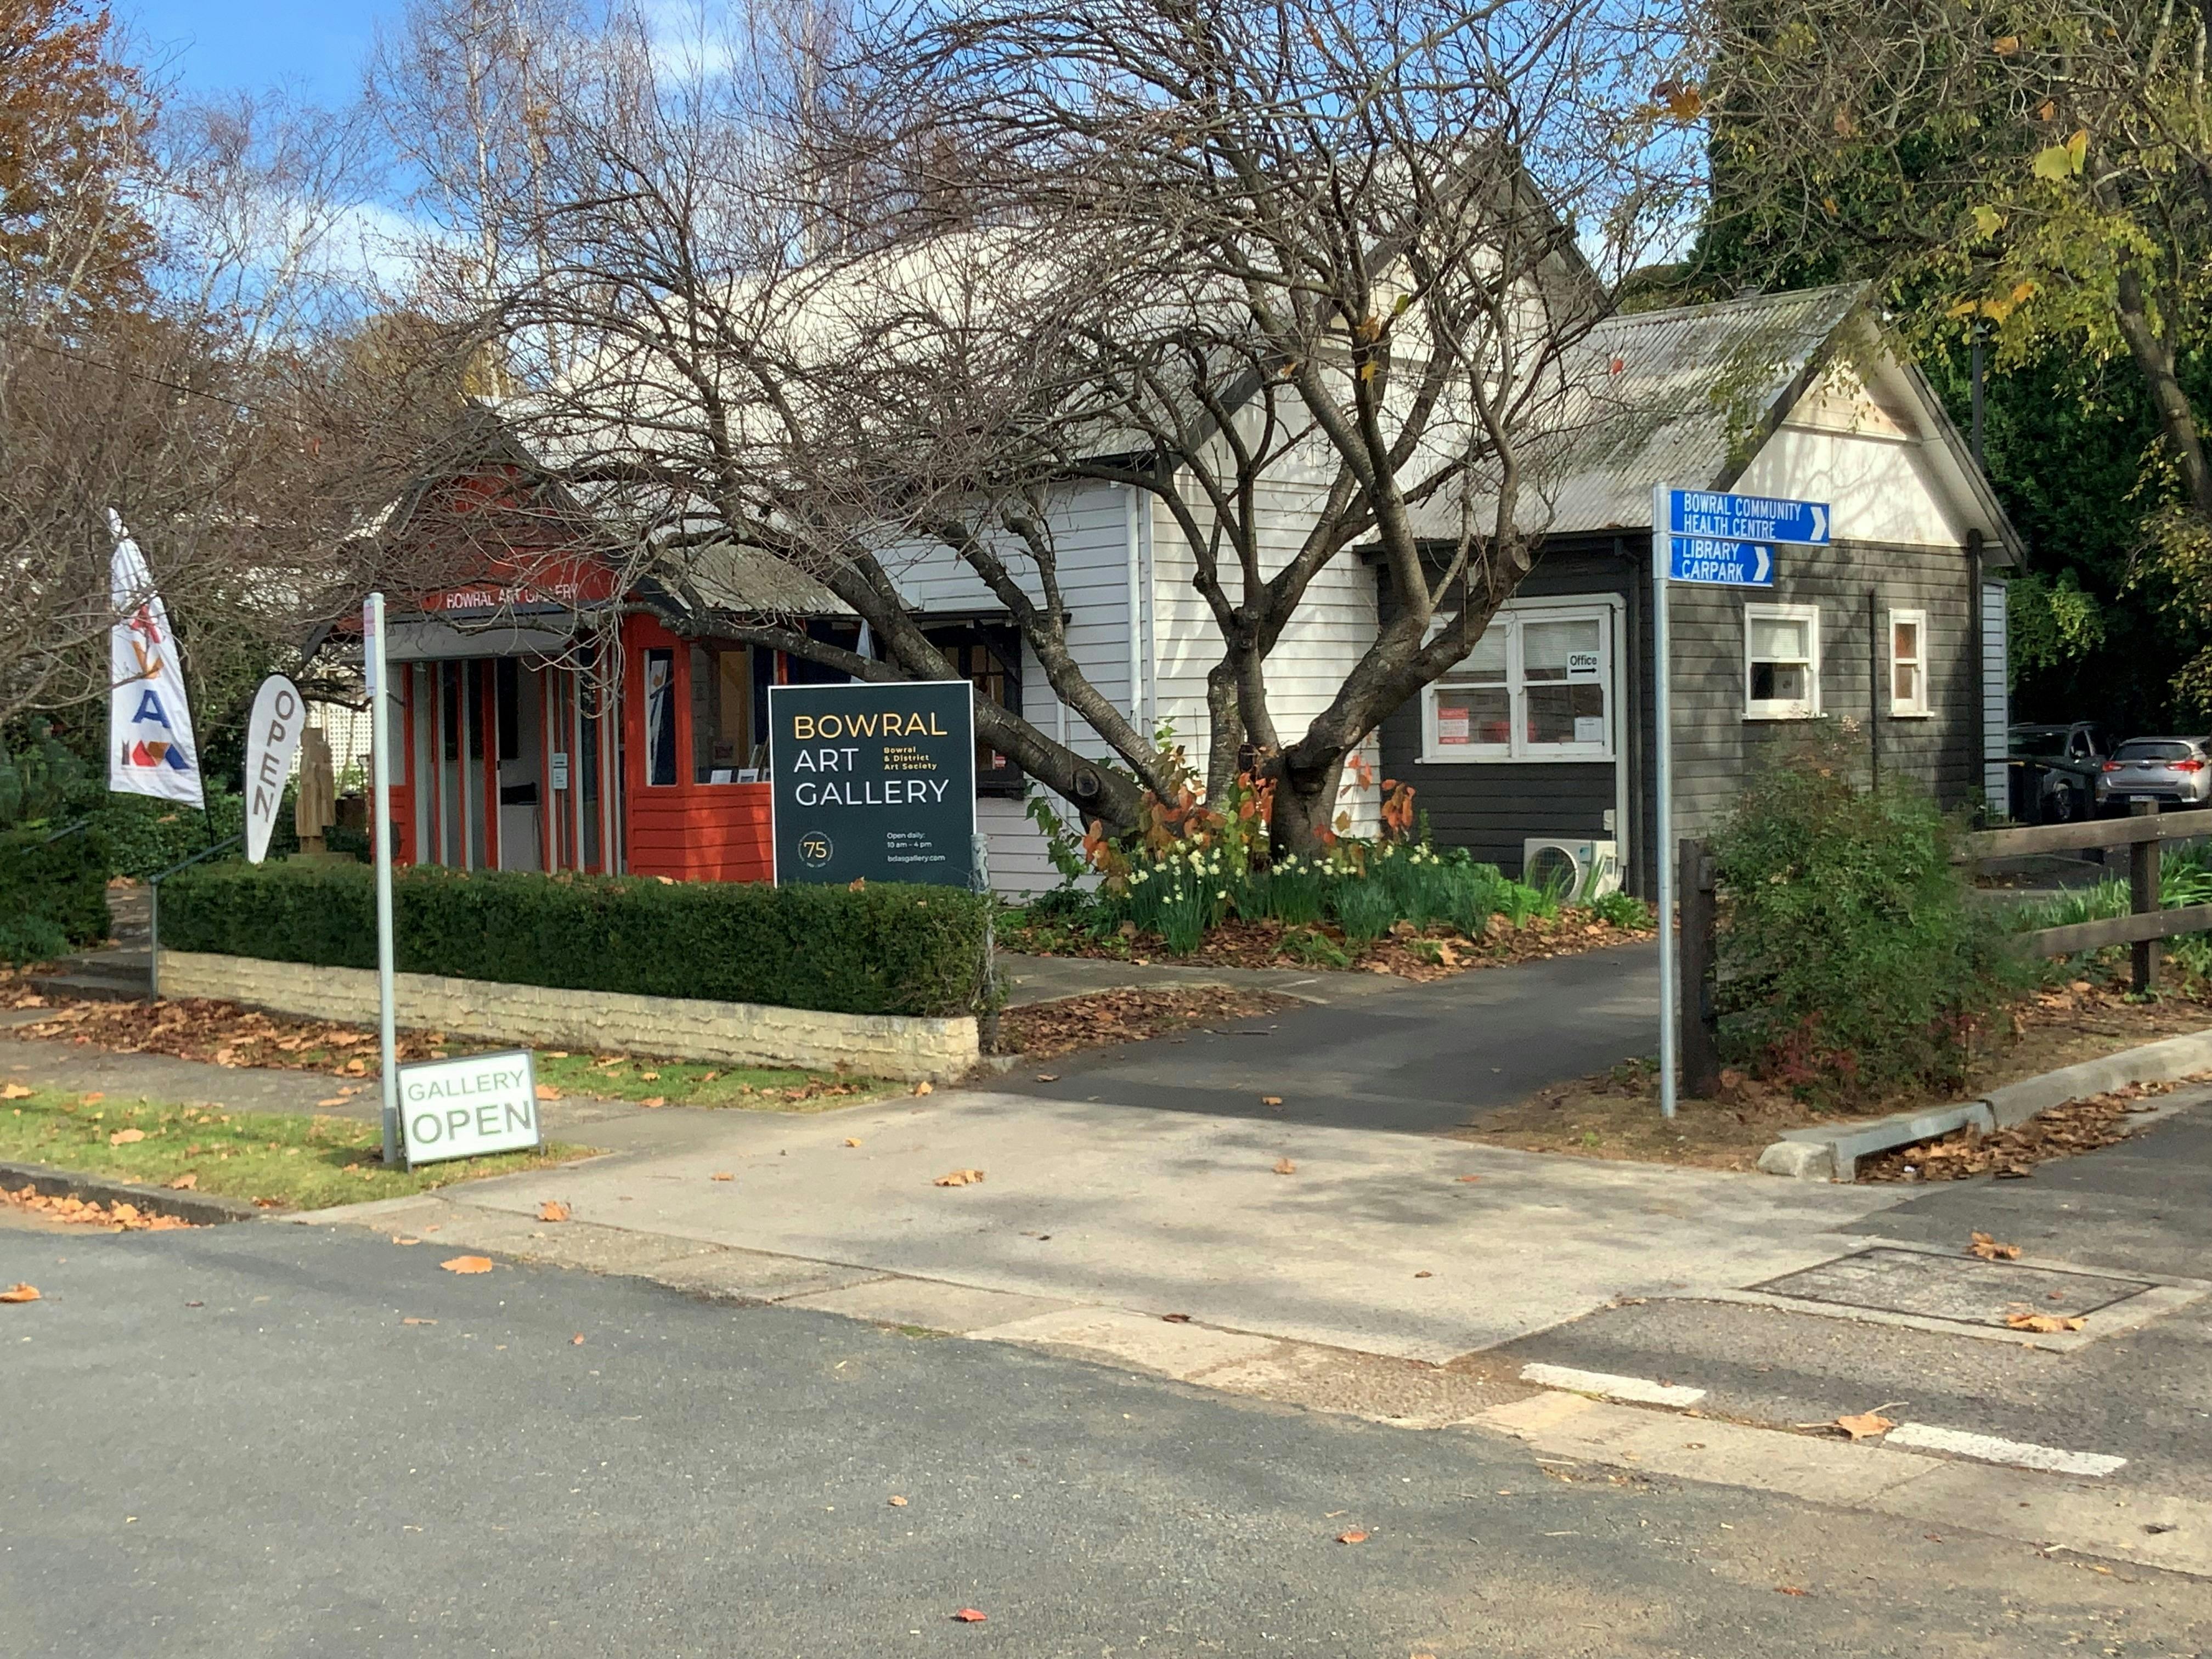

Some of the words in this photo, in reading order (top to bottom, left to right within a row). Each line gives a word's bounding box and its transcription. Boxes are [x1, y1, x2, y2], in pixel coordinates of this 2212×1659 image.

[1684, 493, 1731, 516] BOWRAL
[1735, 498, 1802, 521] COMMUNITY
[1684, 514, 1729, 536] HEALTH
[1733, 518, 1776, 539] CENTRE
[1683, 539, 1740, 561] LIBRARY
[1681, 560, 1744, 582] CARPARK
[447, 592, 494, 609] BOWRAL
[1570, 654, 1598, 666] Office
[793, 712, 948, 740] BOWRAL
[253, 690, 295, 823] OPEN
[793, 748, 860, 773] ART
[893, 754, 929, 762] District
[902, 762, 937, 771] Society
[795, 778, 950, 806] GALLERY
[803, 841, 827, 859] 75
[407, 1069, 524, 1102] GALLERY
[411, 1100, 532, 1145] OPEN
